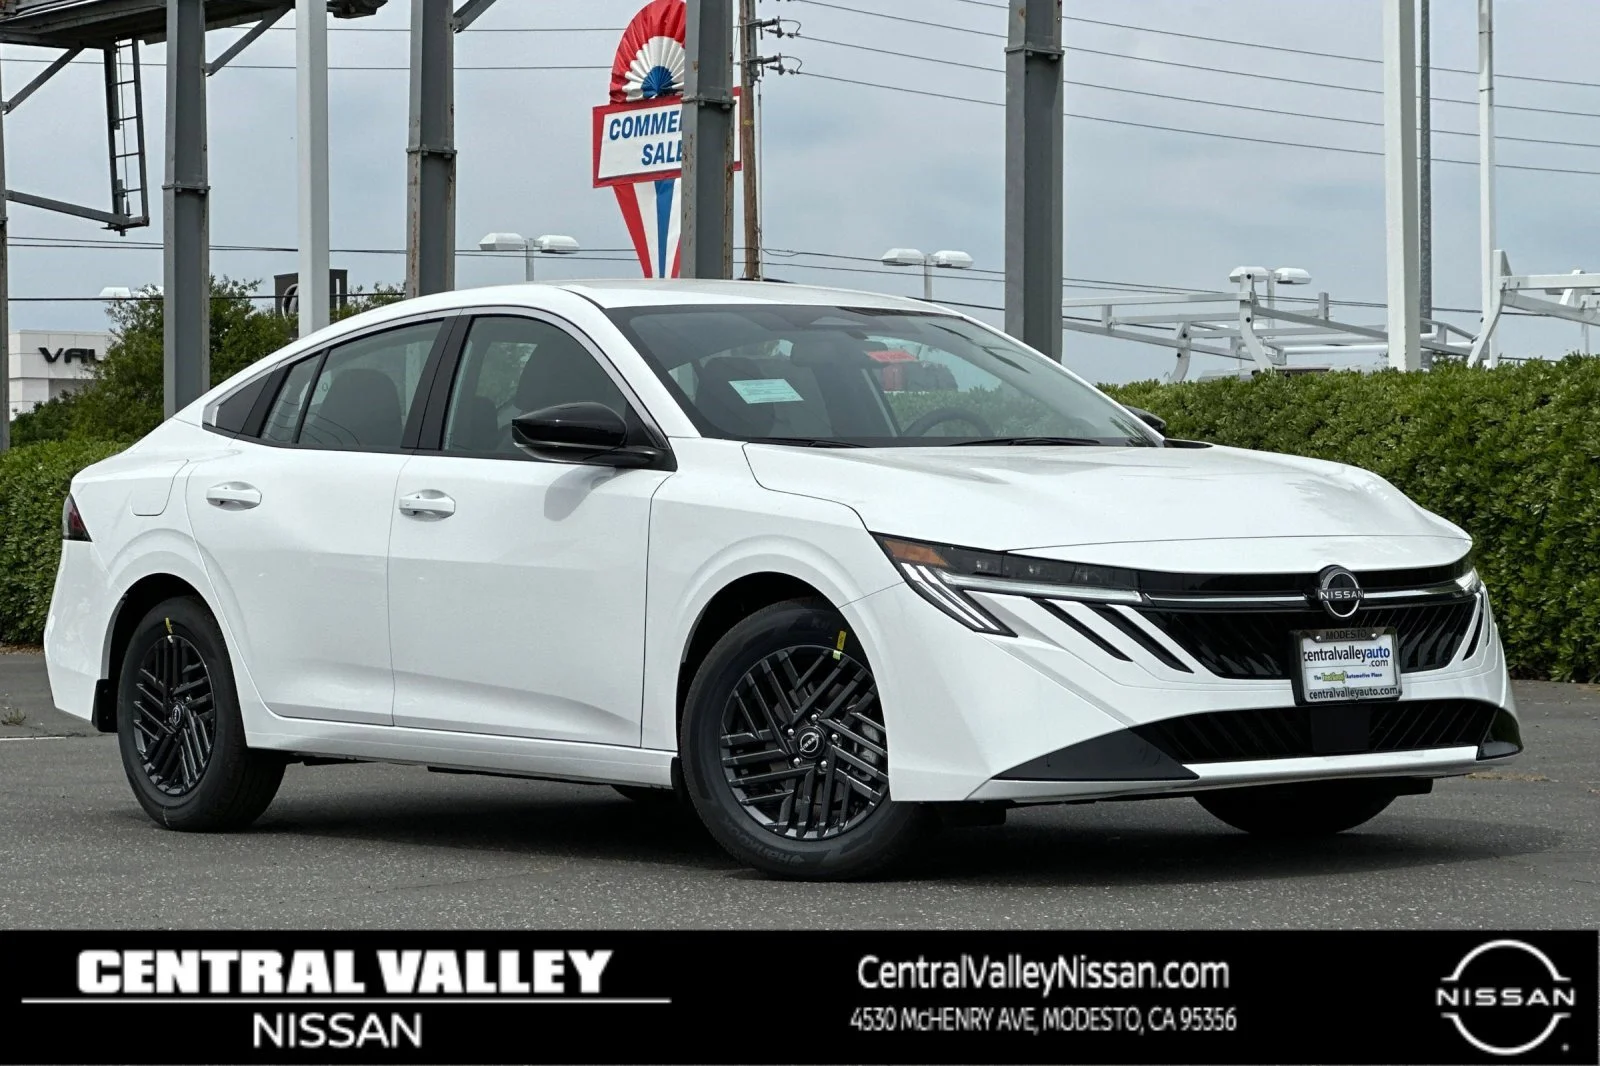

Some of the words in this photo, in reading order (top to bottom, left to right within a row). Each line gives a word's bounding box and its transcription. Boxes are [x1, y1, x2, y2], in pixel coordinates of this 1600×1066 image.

[609, 110, 682, 141] COMME
[1319, 588, 1364, 600] NISSAN
[1325, 629, 1367, 640] MODESTO
[1303, 645, 1390, 663] centralvalleyauto
[1368, 658, 1389, 668] .com
[1309, 687, 1398, 700] centralvalleyauto.com
